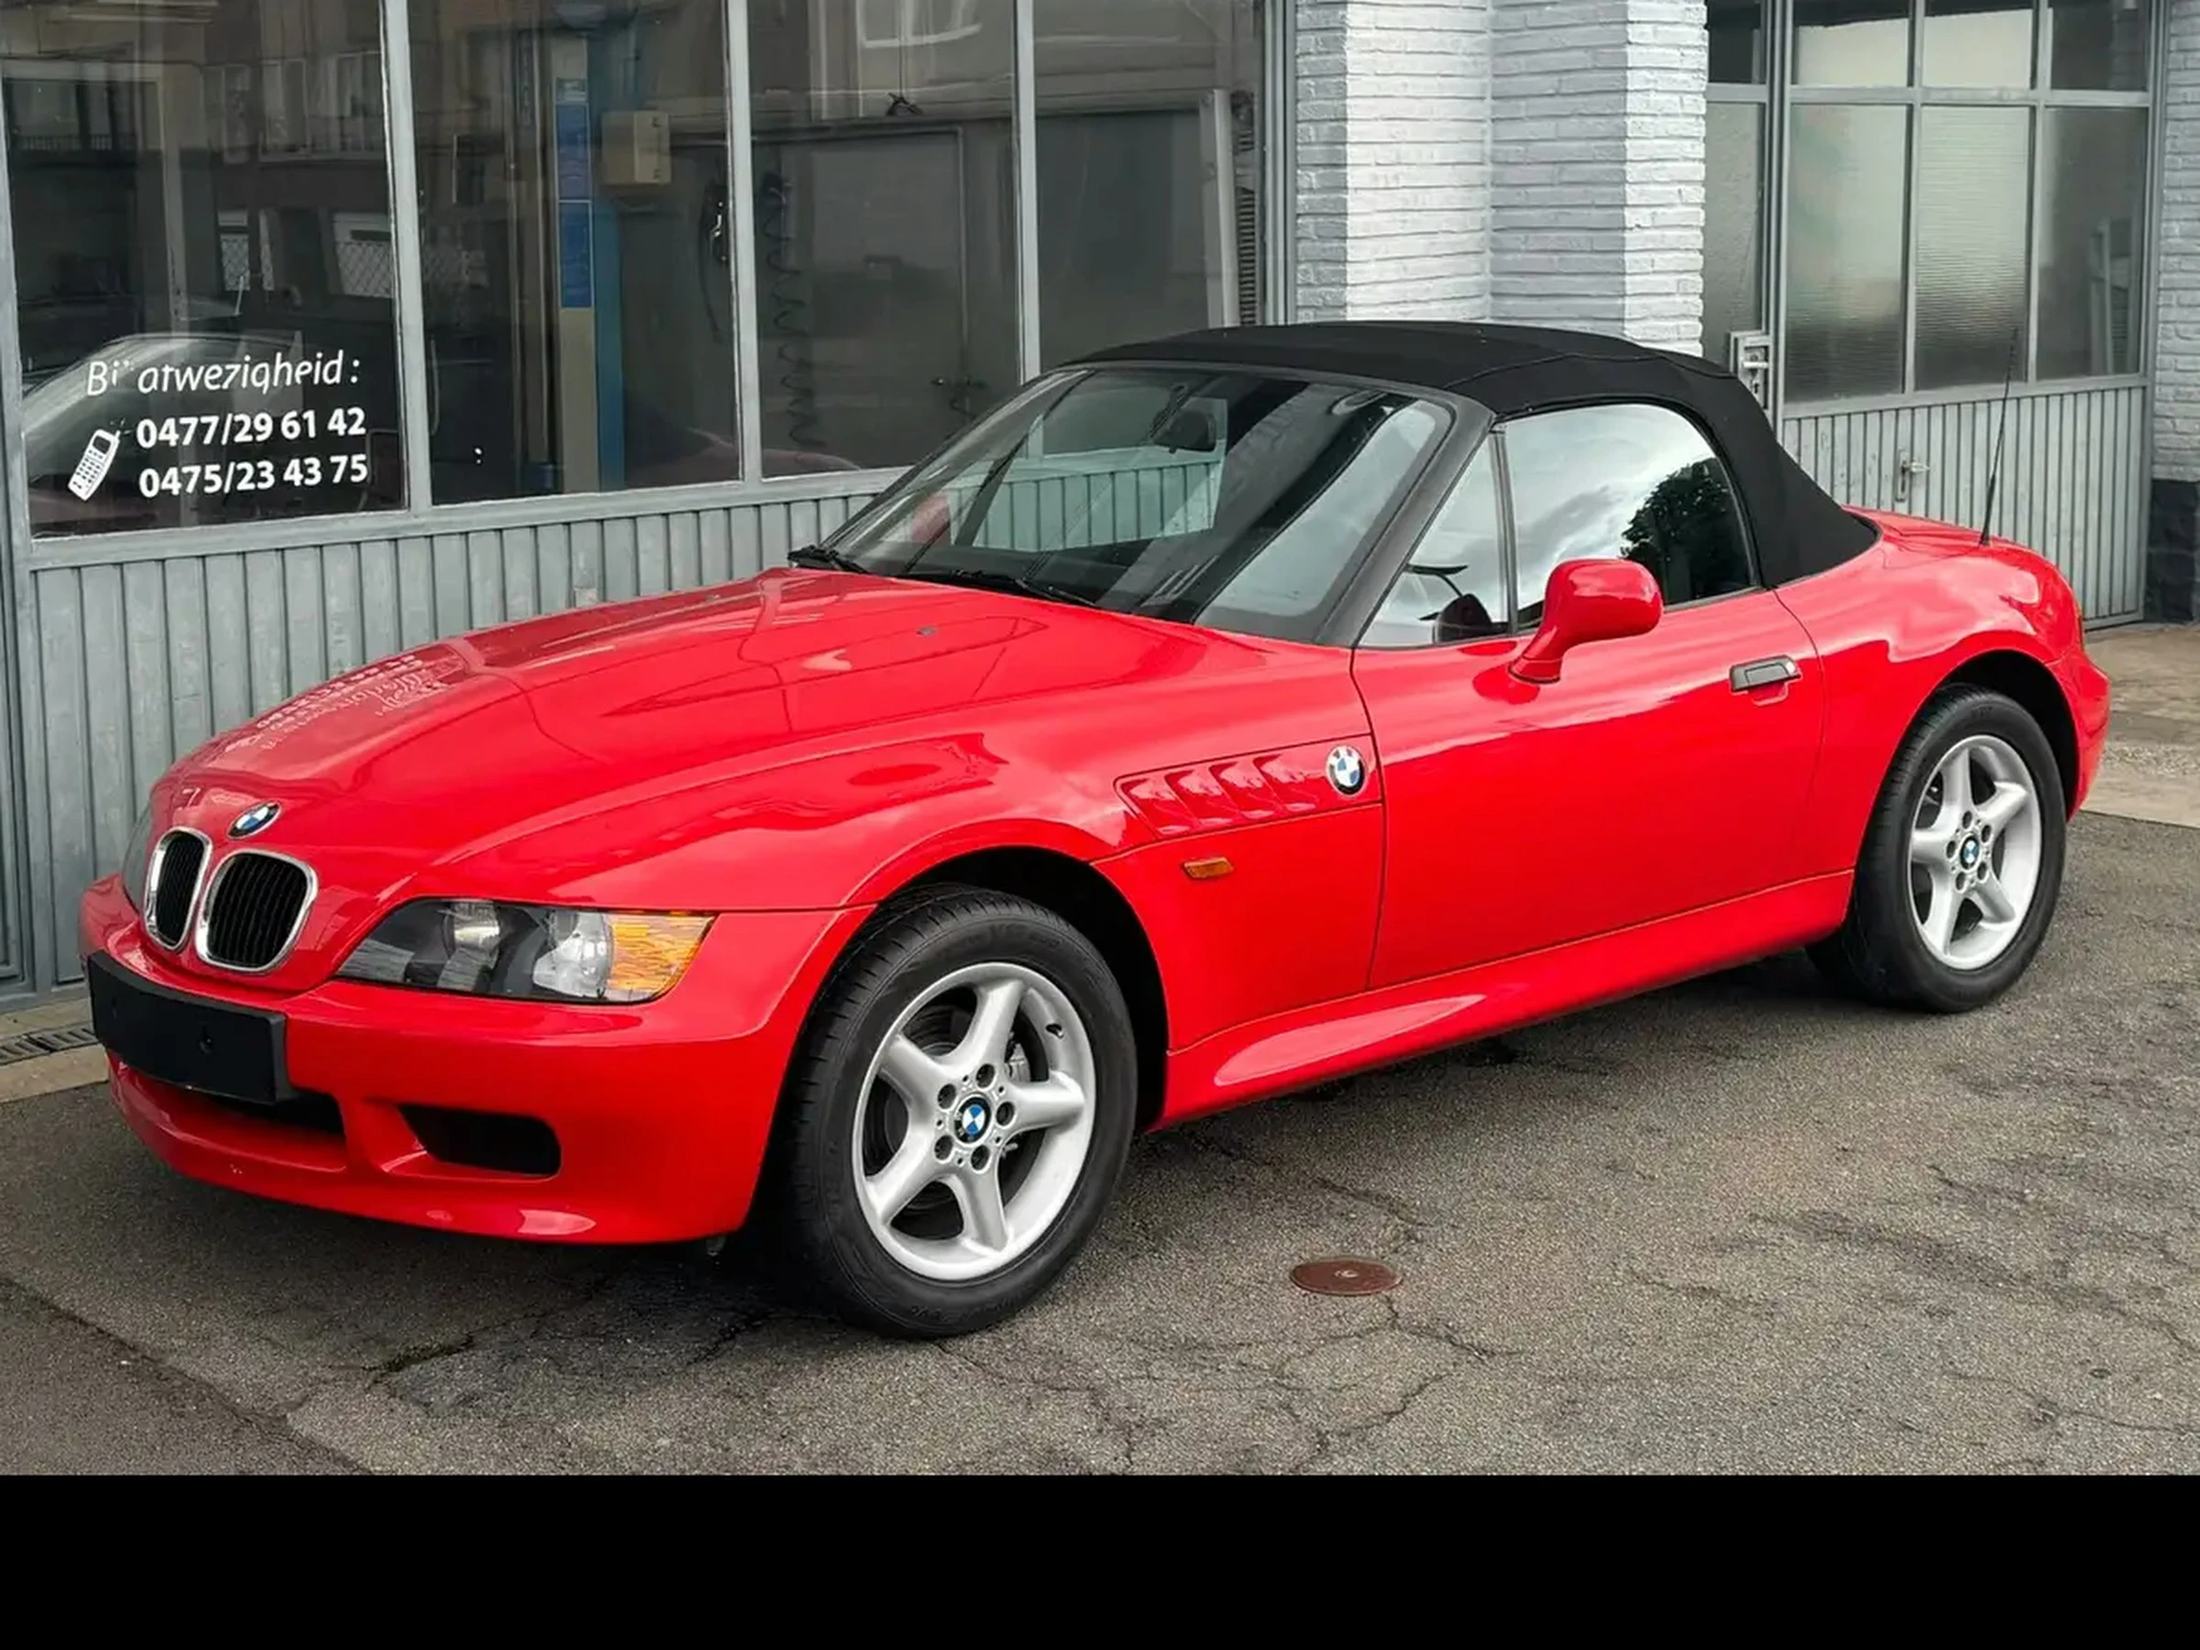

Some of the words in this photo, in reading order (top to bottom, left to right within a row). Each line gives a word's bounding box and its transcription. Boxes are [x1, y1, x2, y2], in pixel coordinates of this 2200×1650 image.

[87, 358, 134, 396] Bi
[137, 412, 273, 449] 0477/29
[280, 410, 316, 440] 61
[327, 407, 367, 437] 42
[138, 460, 275, 498] 0475/23
[283, 457, 323, 487] 43
[330, 453, 369, 484] 75
